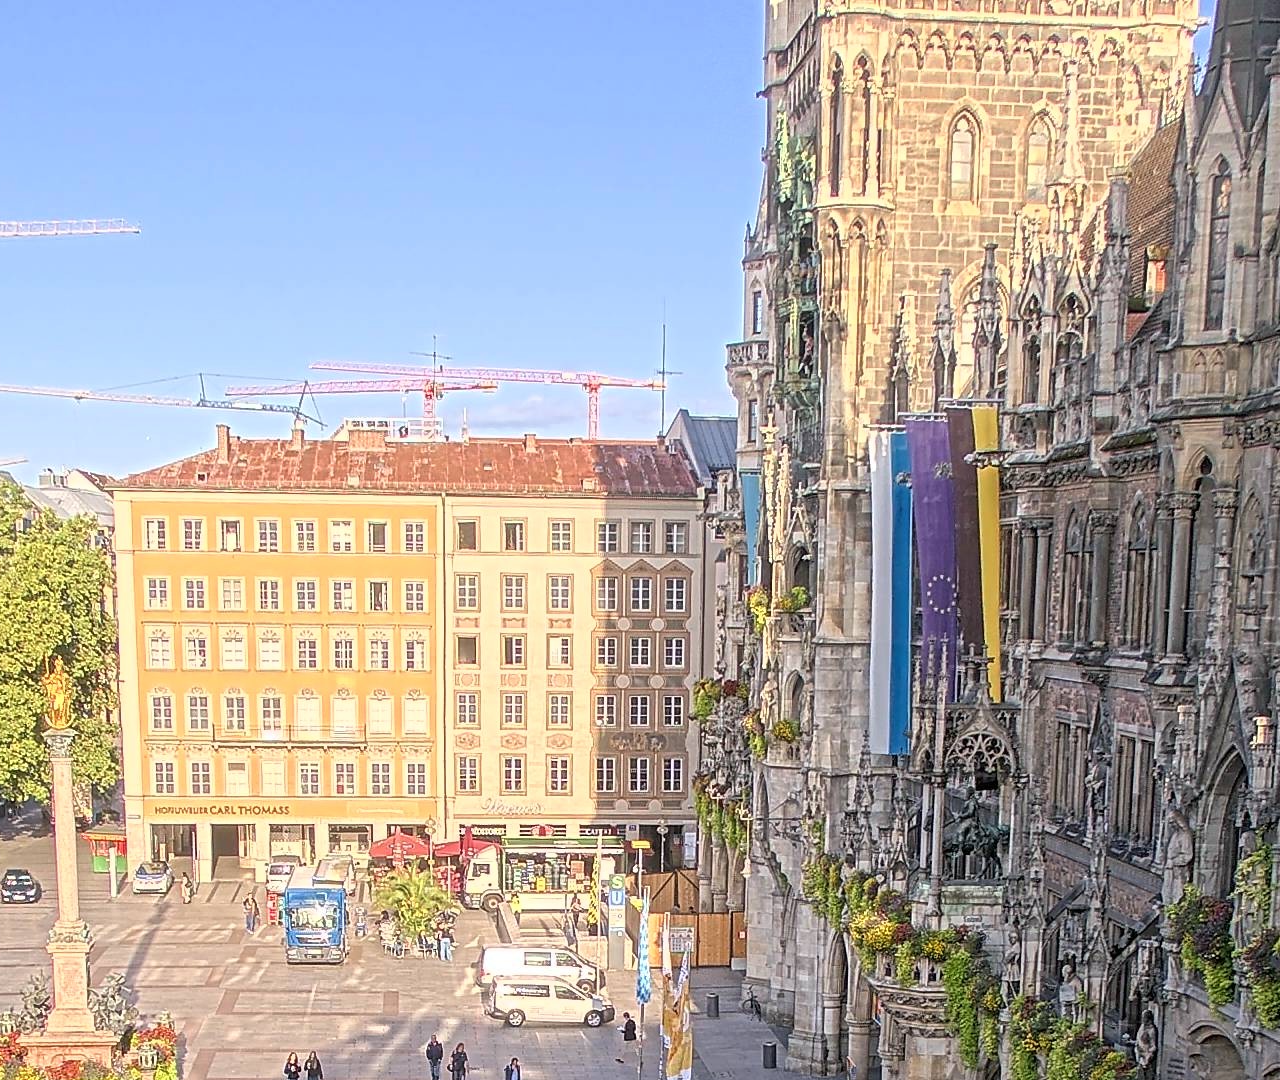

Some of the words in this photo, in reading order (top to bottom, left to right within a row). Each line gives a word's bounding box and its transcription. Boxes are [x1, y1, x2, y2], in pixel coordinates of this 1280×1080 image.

[209, 805, 236, 815] CARL
[238, 805, 290, 815] THOMASS
[611, 876, 624, 889] S
